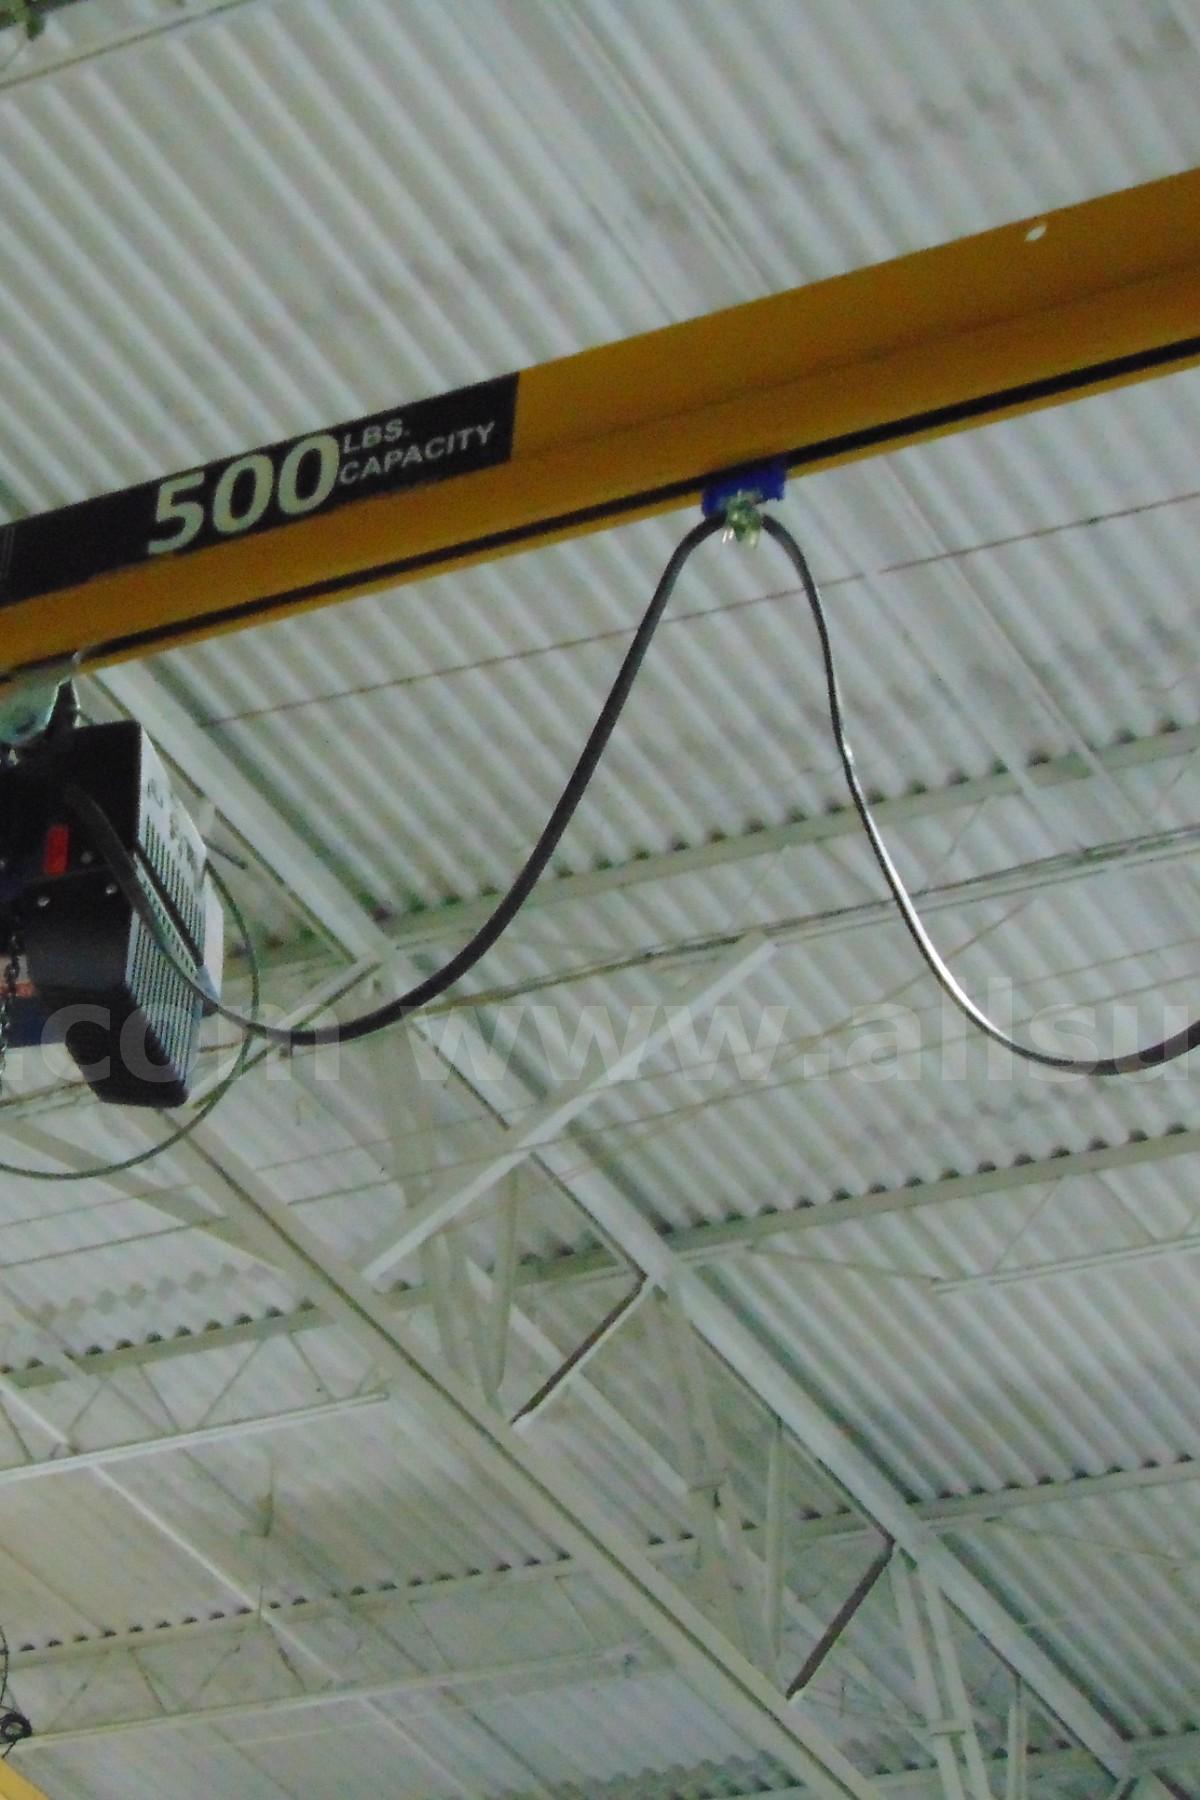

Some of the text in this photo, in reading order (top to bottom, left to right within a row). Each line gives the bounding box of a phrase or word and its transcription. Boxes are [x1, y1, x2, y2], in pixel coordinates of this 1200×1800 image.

[147, 418, 410, 555] 500 LBS.
[339, 421, 495, 485] CAPACITY
